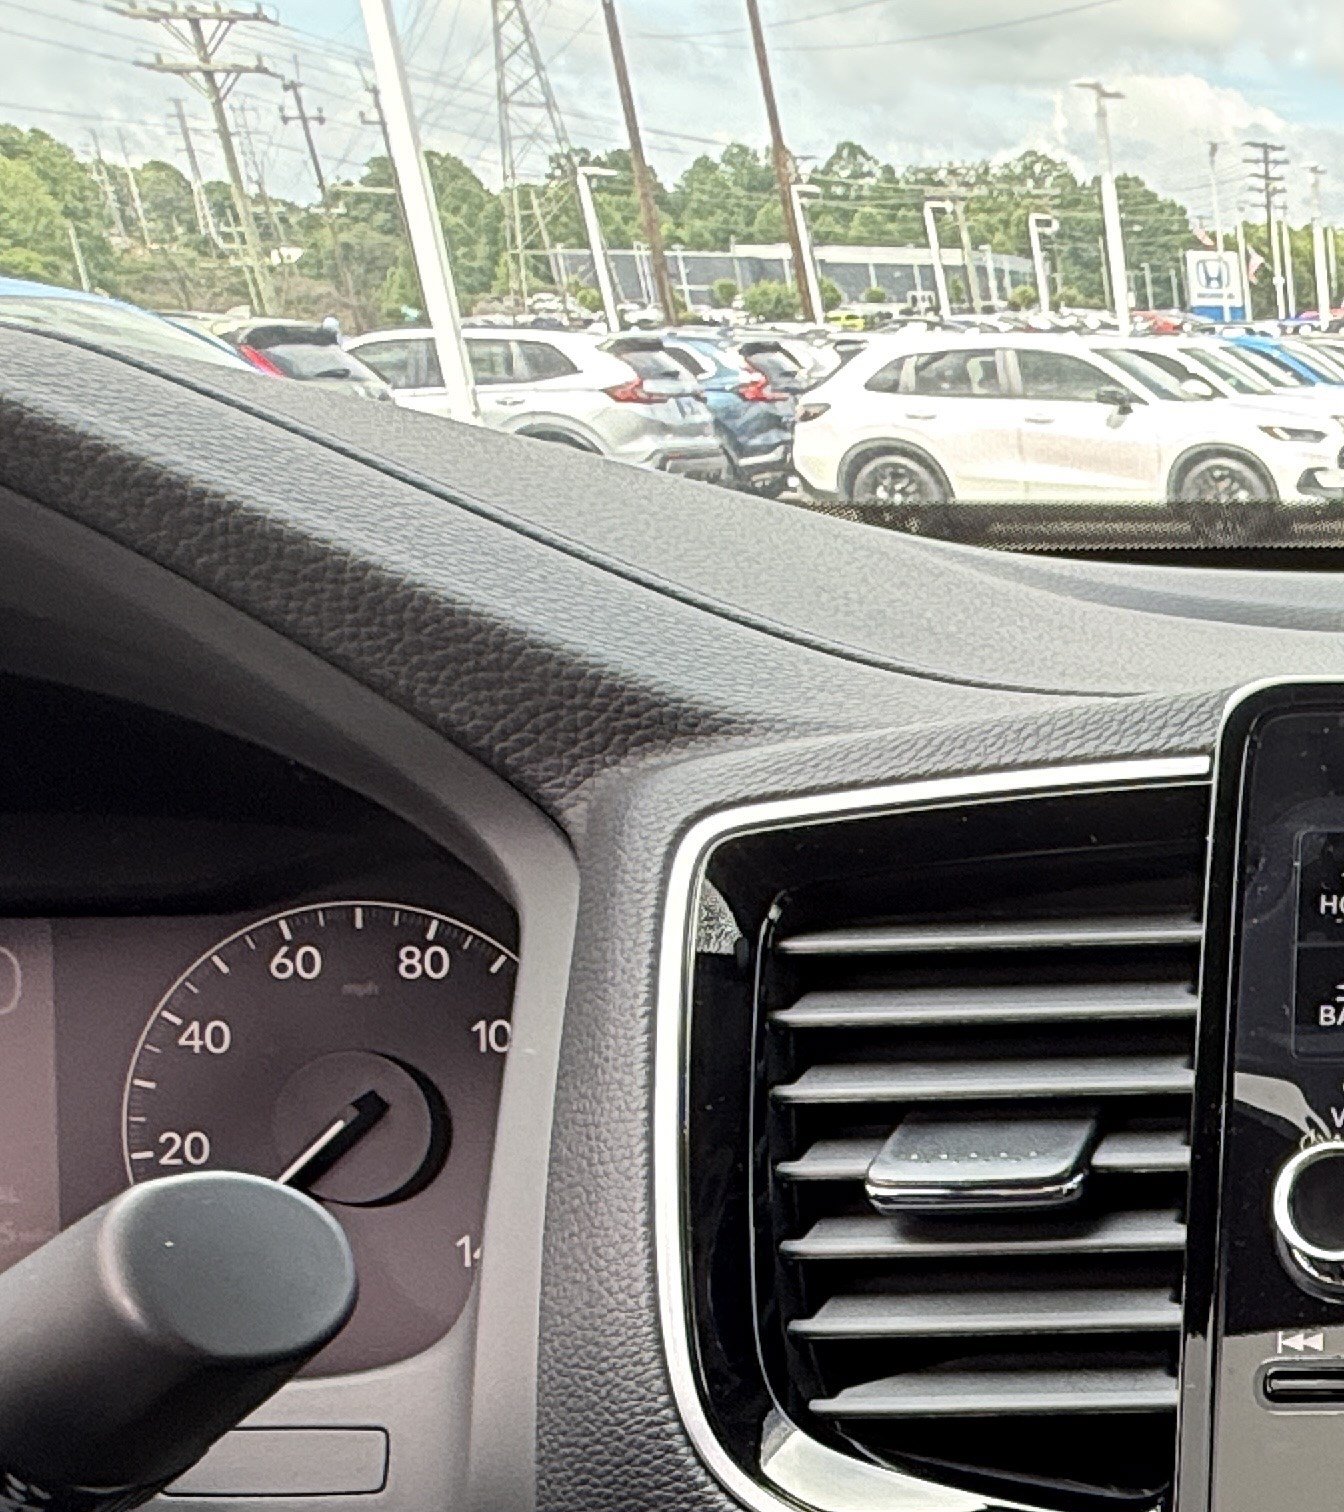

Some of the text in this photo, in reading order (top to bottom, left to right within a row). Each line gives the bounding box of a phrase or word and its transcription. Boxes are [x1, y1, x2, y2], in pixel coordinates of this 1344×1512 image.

[270, 946, 322, 980] 60
[398, 946, 450, 979] 80
[178, 1020, 230, 1054] 40
[158, 1131, 210, 1165] 20
